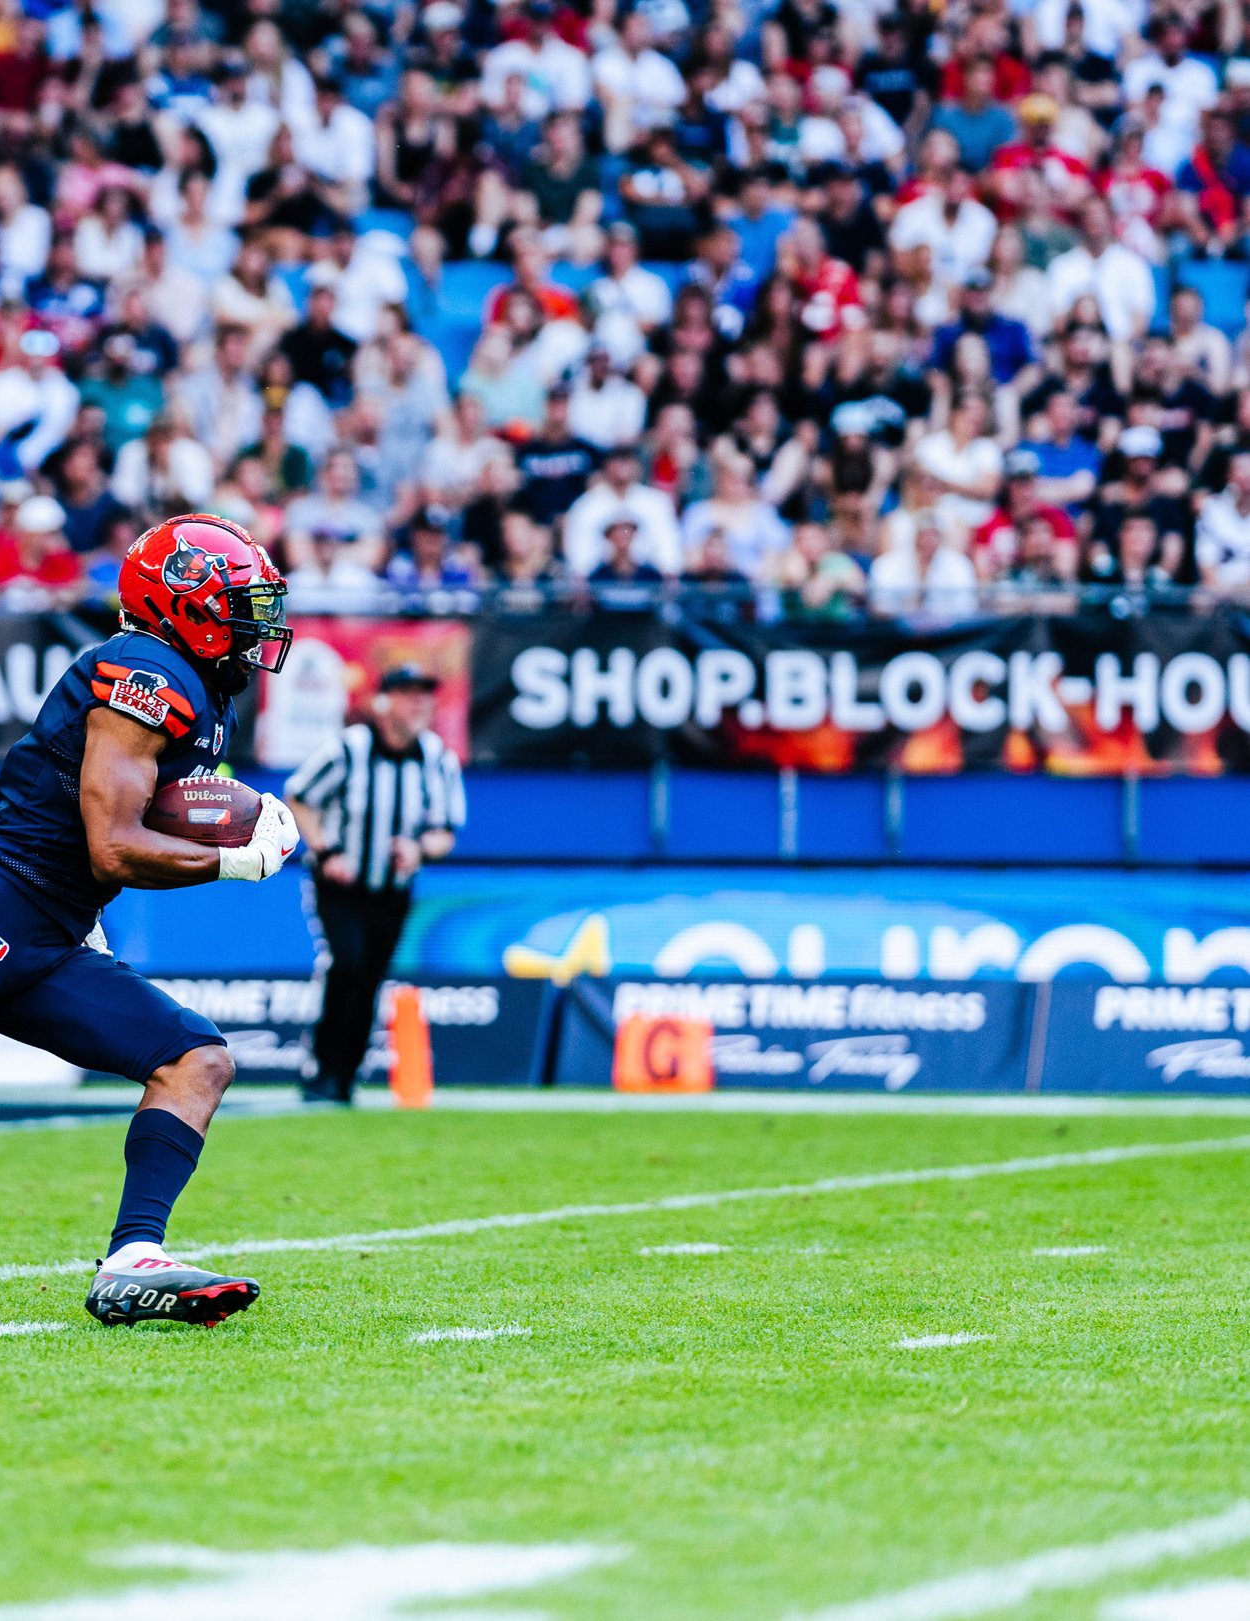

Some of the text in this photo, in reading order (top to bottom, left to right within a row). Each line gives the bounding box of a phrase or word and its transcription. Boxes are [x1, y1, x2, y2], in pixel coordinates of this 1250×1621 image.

[113, 691, 163, 722] HOUSE
[117, 682, 167, 713] BLOCK
[183, 791, 232, 802] Wilson
[749, 985, 850, 1031] TIME
[645, 1020, 680, 1082] G
[90, 1281, 178, 1313] VAPOR
